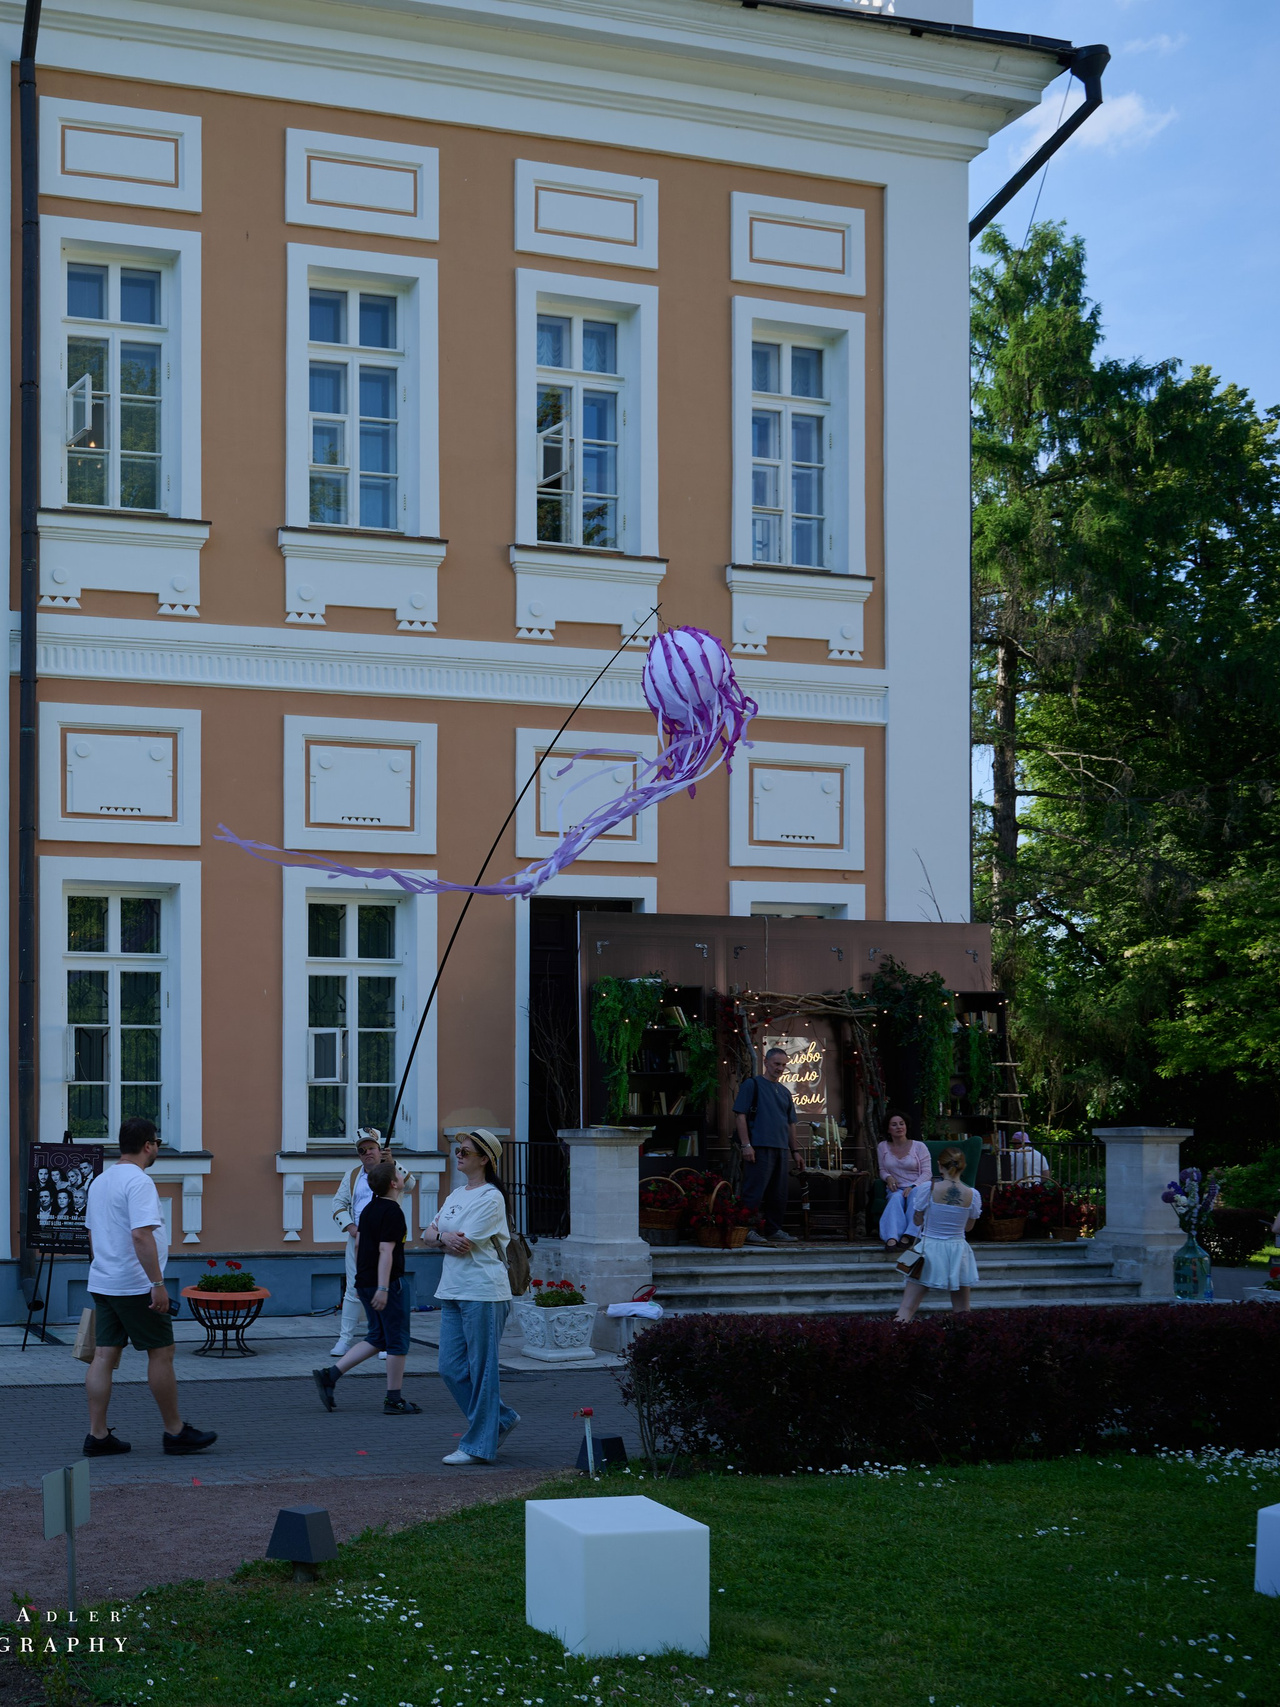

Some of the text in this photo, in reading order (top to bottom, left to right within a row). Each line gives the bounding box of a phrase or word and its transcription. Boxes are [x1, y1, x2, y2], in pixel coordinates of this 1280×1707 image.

[786, 1041, 823, 1065] лово
[778, 1071, 819, 1083] тало
[792, 1093, 826, 1106] том
[33, 1151, 100, 1169] ПОЭТ
